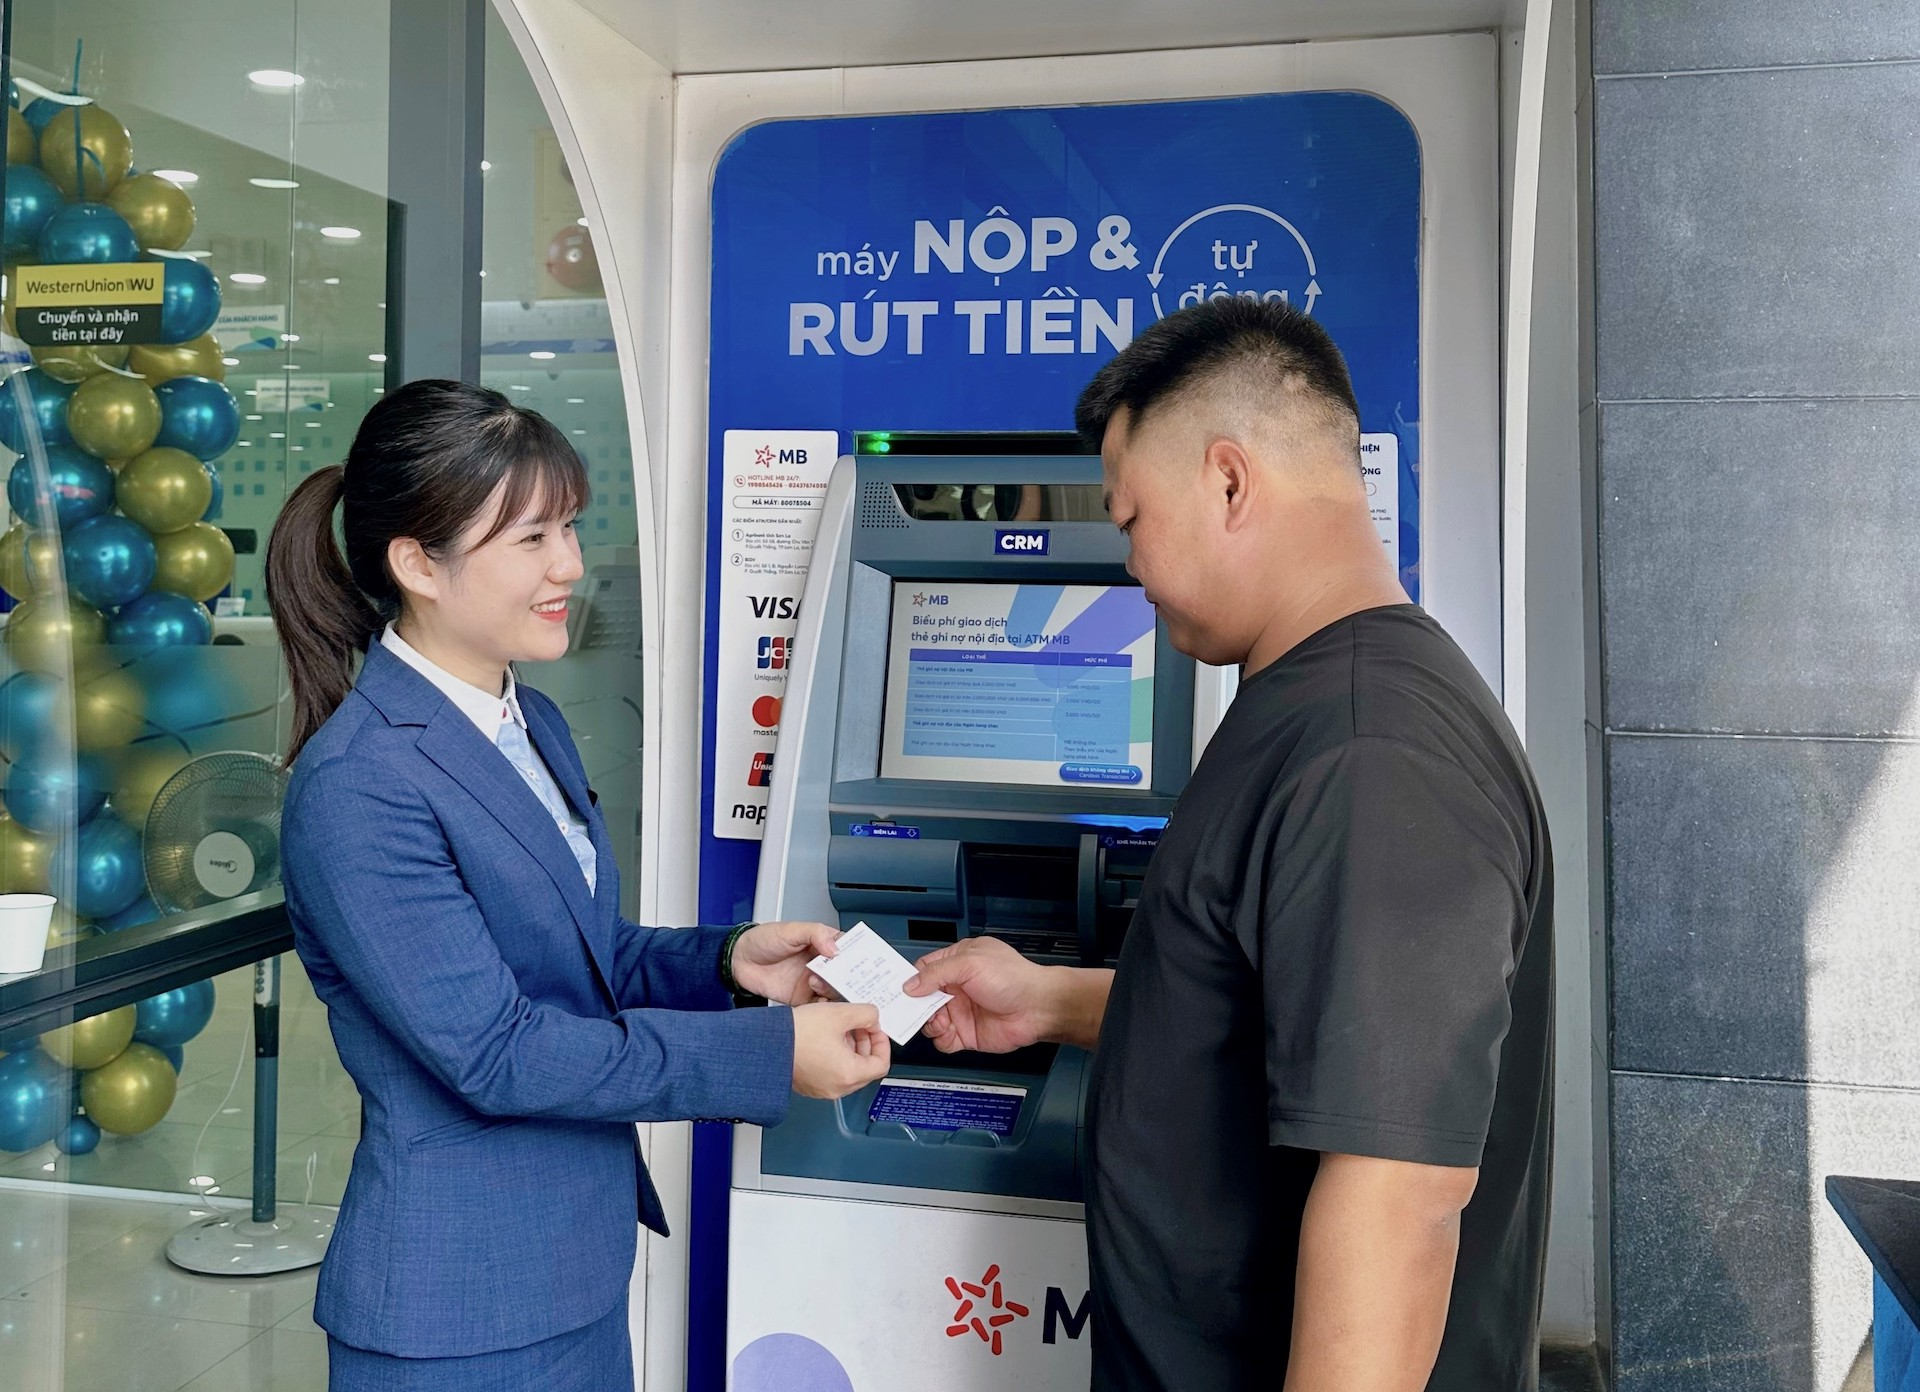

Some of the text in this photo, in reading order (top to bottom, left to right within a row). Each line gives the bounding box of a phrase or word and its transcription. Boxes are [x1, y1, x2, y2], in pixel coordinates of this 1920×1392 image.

[817, 206, 1140, 286] máy NỘP &
[1212, 239, 1257, 277] tự
[26, 278, 124, 294] WesternUnion
[38, 307, 139, 327] Chuyển và nhận
[789, 286, 1133, 356] RÚT TIỀN
[52, 326, 124, 343] tiền tại đây
[779, 449, 808, 464] MB
[1001, 535, 1043, 550] CRM
[929, 595, 949, 605] MB
[912, 614, 1008, 629] Biểu phí giao dịch
[911, 631, 1070, 646] thẻ ghi nợ nội địa tại ATM MB
[754, 674, 783, 682] Uniquely
[753, 729, 778, 737] maste
[731, 804, 767, 825] nap
